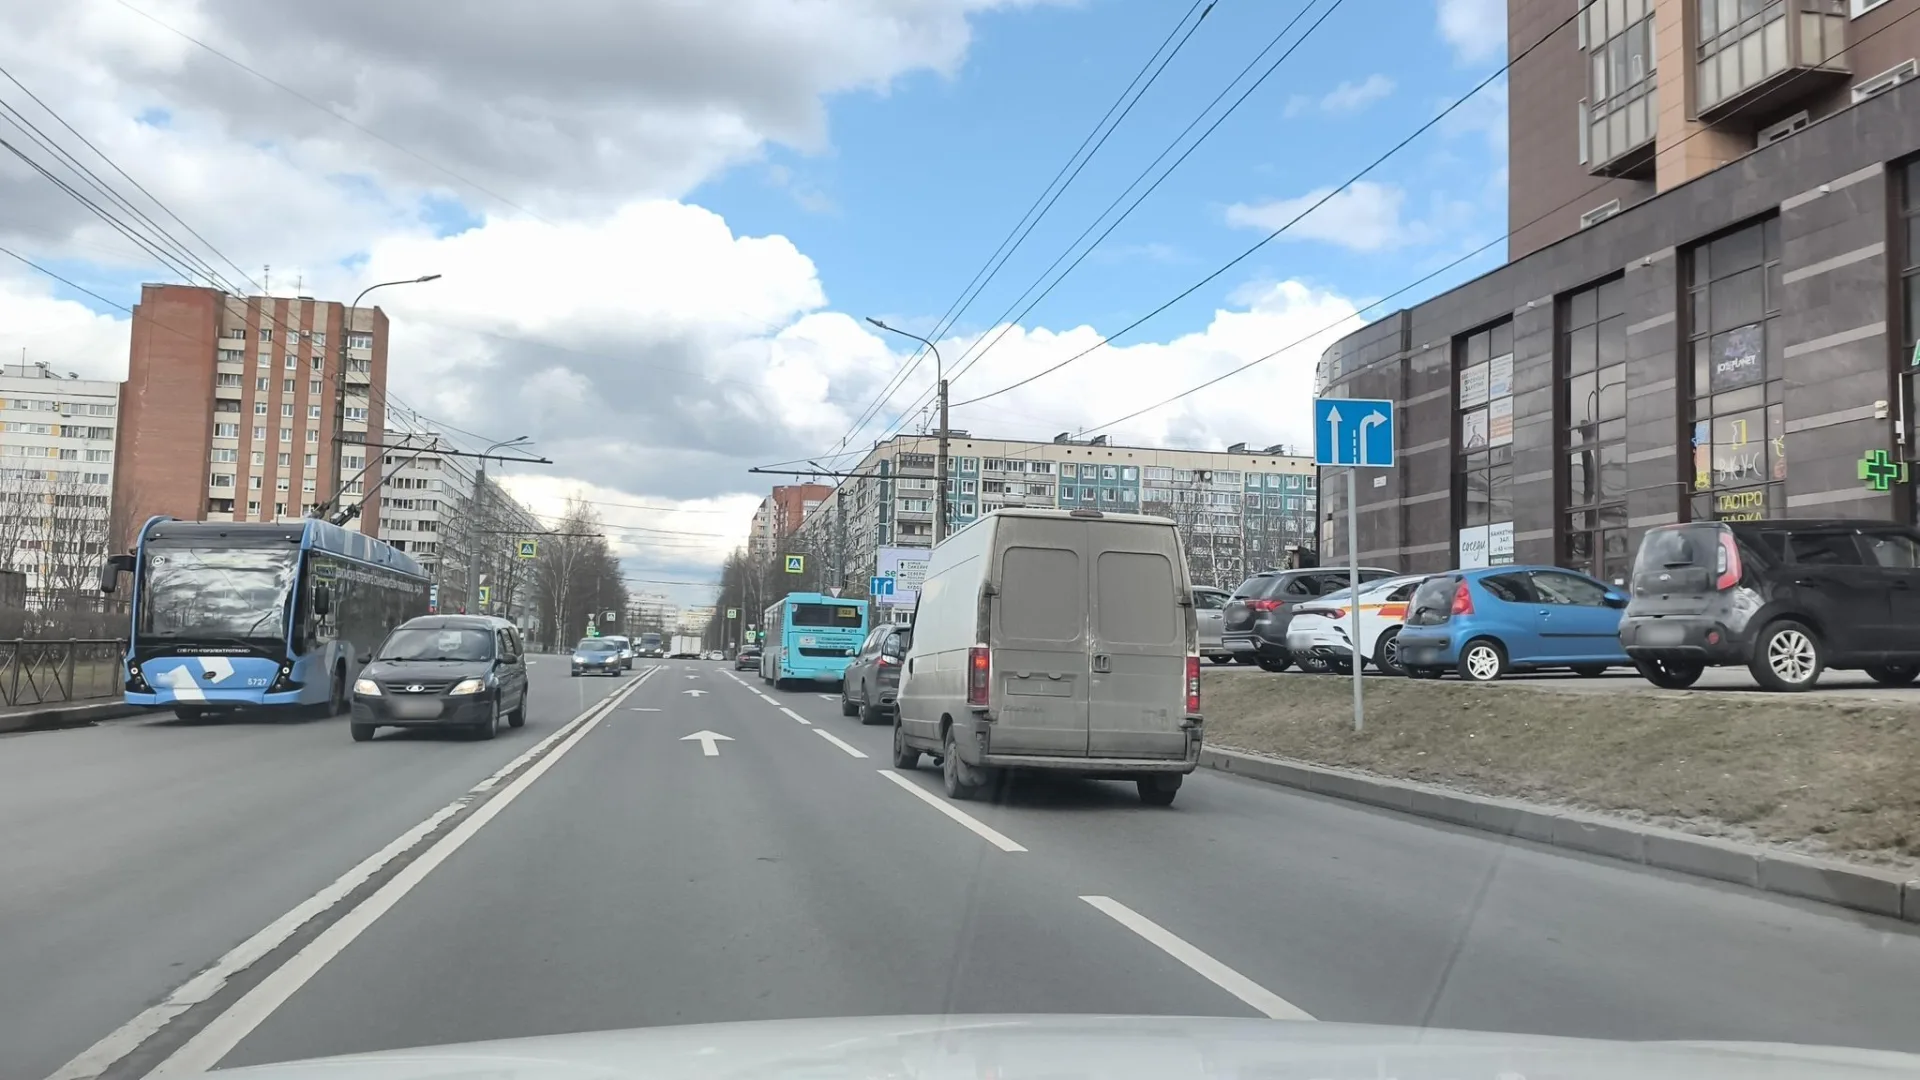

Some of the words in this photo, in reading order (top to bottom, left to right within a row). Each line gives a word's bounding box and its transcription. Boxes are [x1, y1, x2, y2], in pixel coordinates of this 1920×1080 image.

[1720, 491, 1763, 510] ГАСТРО
[1721, 511, 1763, 521] РКА
[247, 678, 268, 686] 5727
